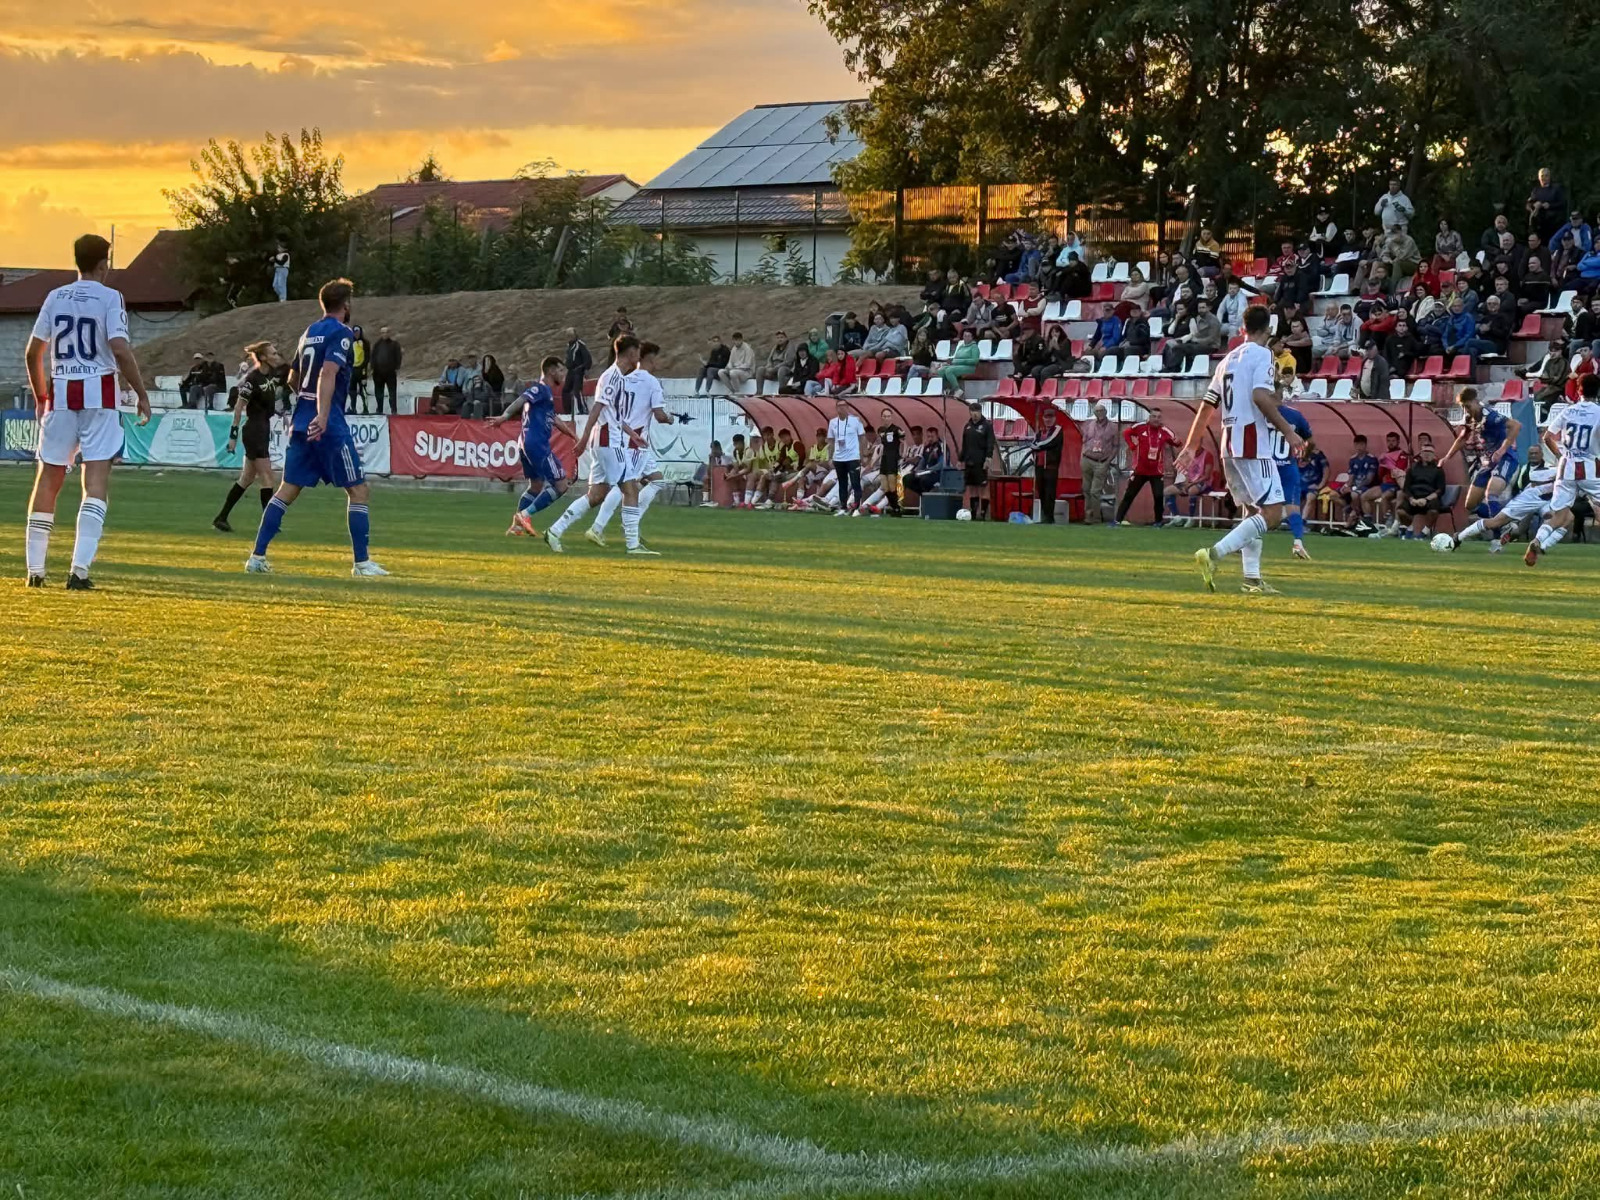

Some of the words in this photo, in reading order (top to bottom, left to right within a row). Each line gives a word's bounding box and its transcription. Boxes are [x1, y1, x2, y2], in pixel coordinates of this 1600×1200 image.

[55, 315, 97, 360] 20
[414, 430, 520, 468] SUPERSCO
[1563, 422, 1594, 452] 30
